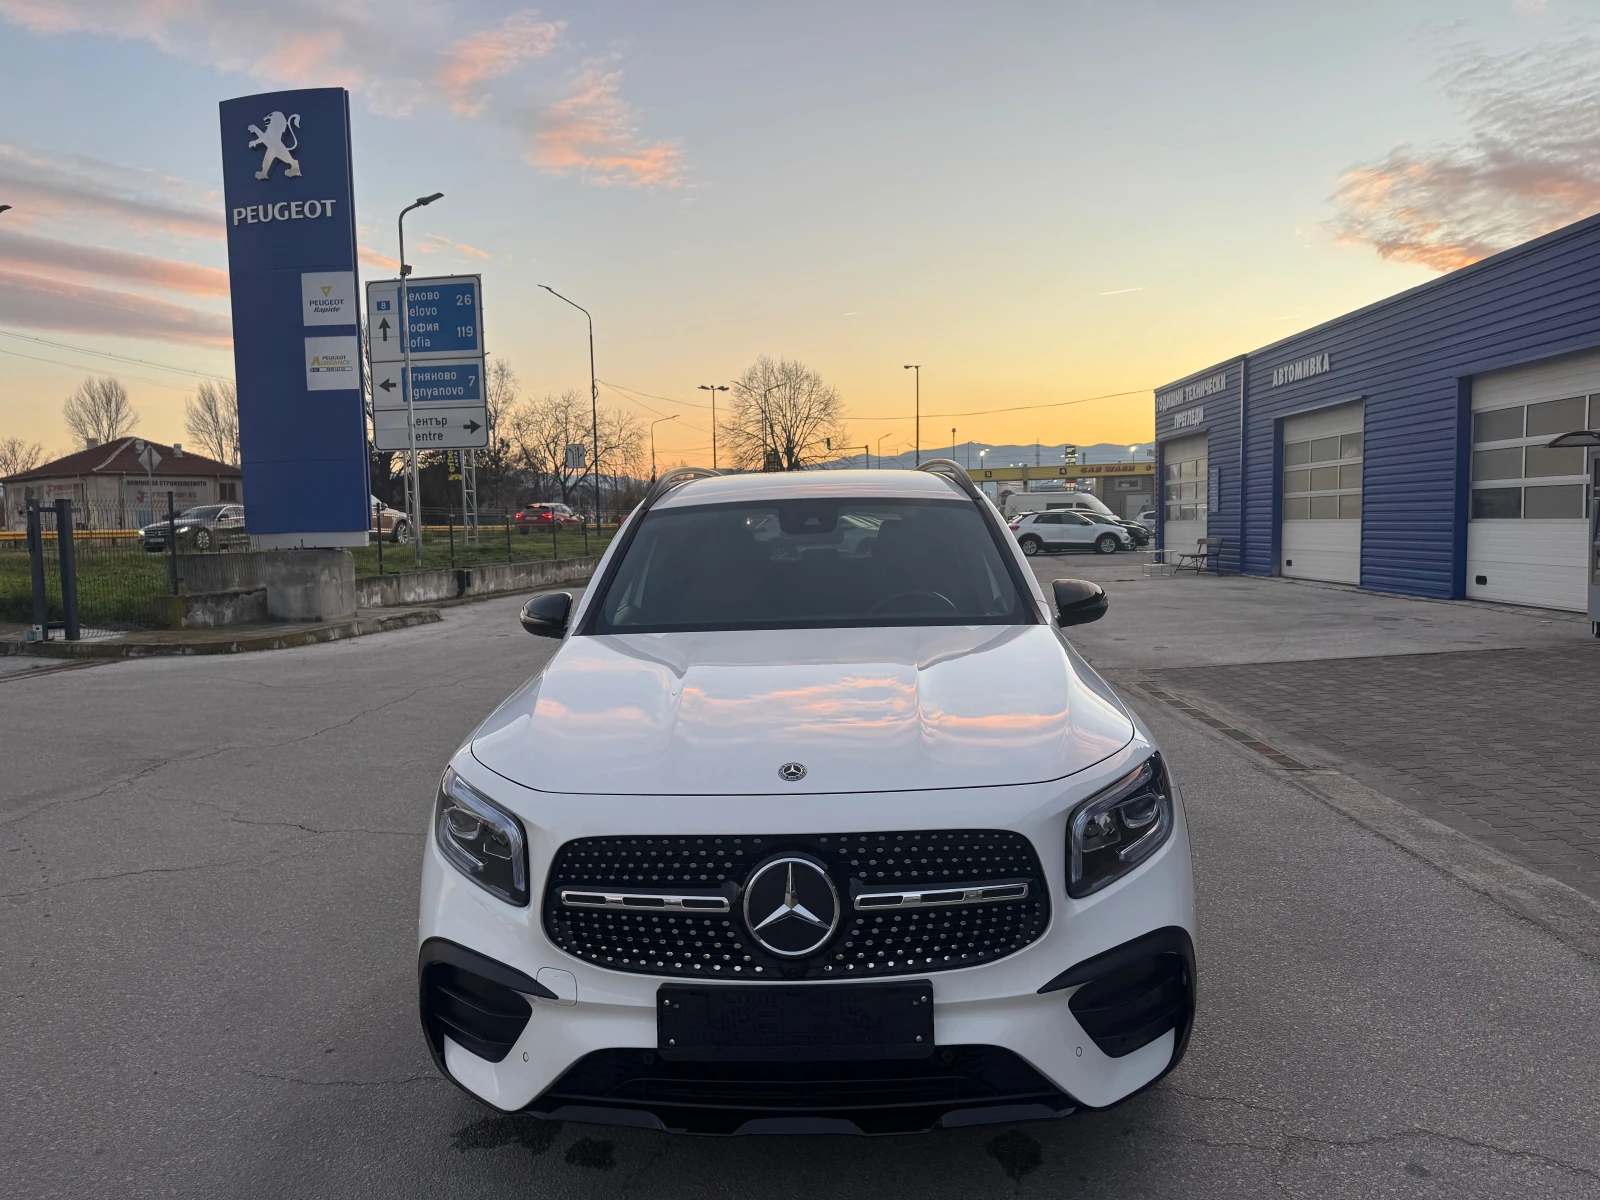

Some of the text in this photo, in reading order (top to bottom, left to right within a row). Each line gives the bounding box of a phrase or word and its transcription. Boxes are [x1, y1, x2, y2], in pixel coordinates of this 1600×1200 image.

[233, 200, 337, 226] PEUGEOT
[380, 302, 387, 310] 8
[402, 291, 472, 306] елово 26
[403, 305, 438, 317] elovo
[404, 322, 473, 338] офия 119
[404, 336, 431, 348] ofia
[1272, 353, 1330, 387] АВТОМИВКА
[405, 371, 476, 387] гняново 7
[406, 386, 464, 400] gnyanovo
[1156, 373, 1226, 412] ГОДИШНИ ТЕХНИЧЕСКИ
[1174, 406, 1204, 429] ПРЕГЛЕДИ
[408, 431, 444, 441] entre
[1105, 465, 1135, 473] WASH
